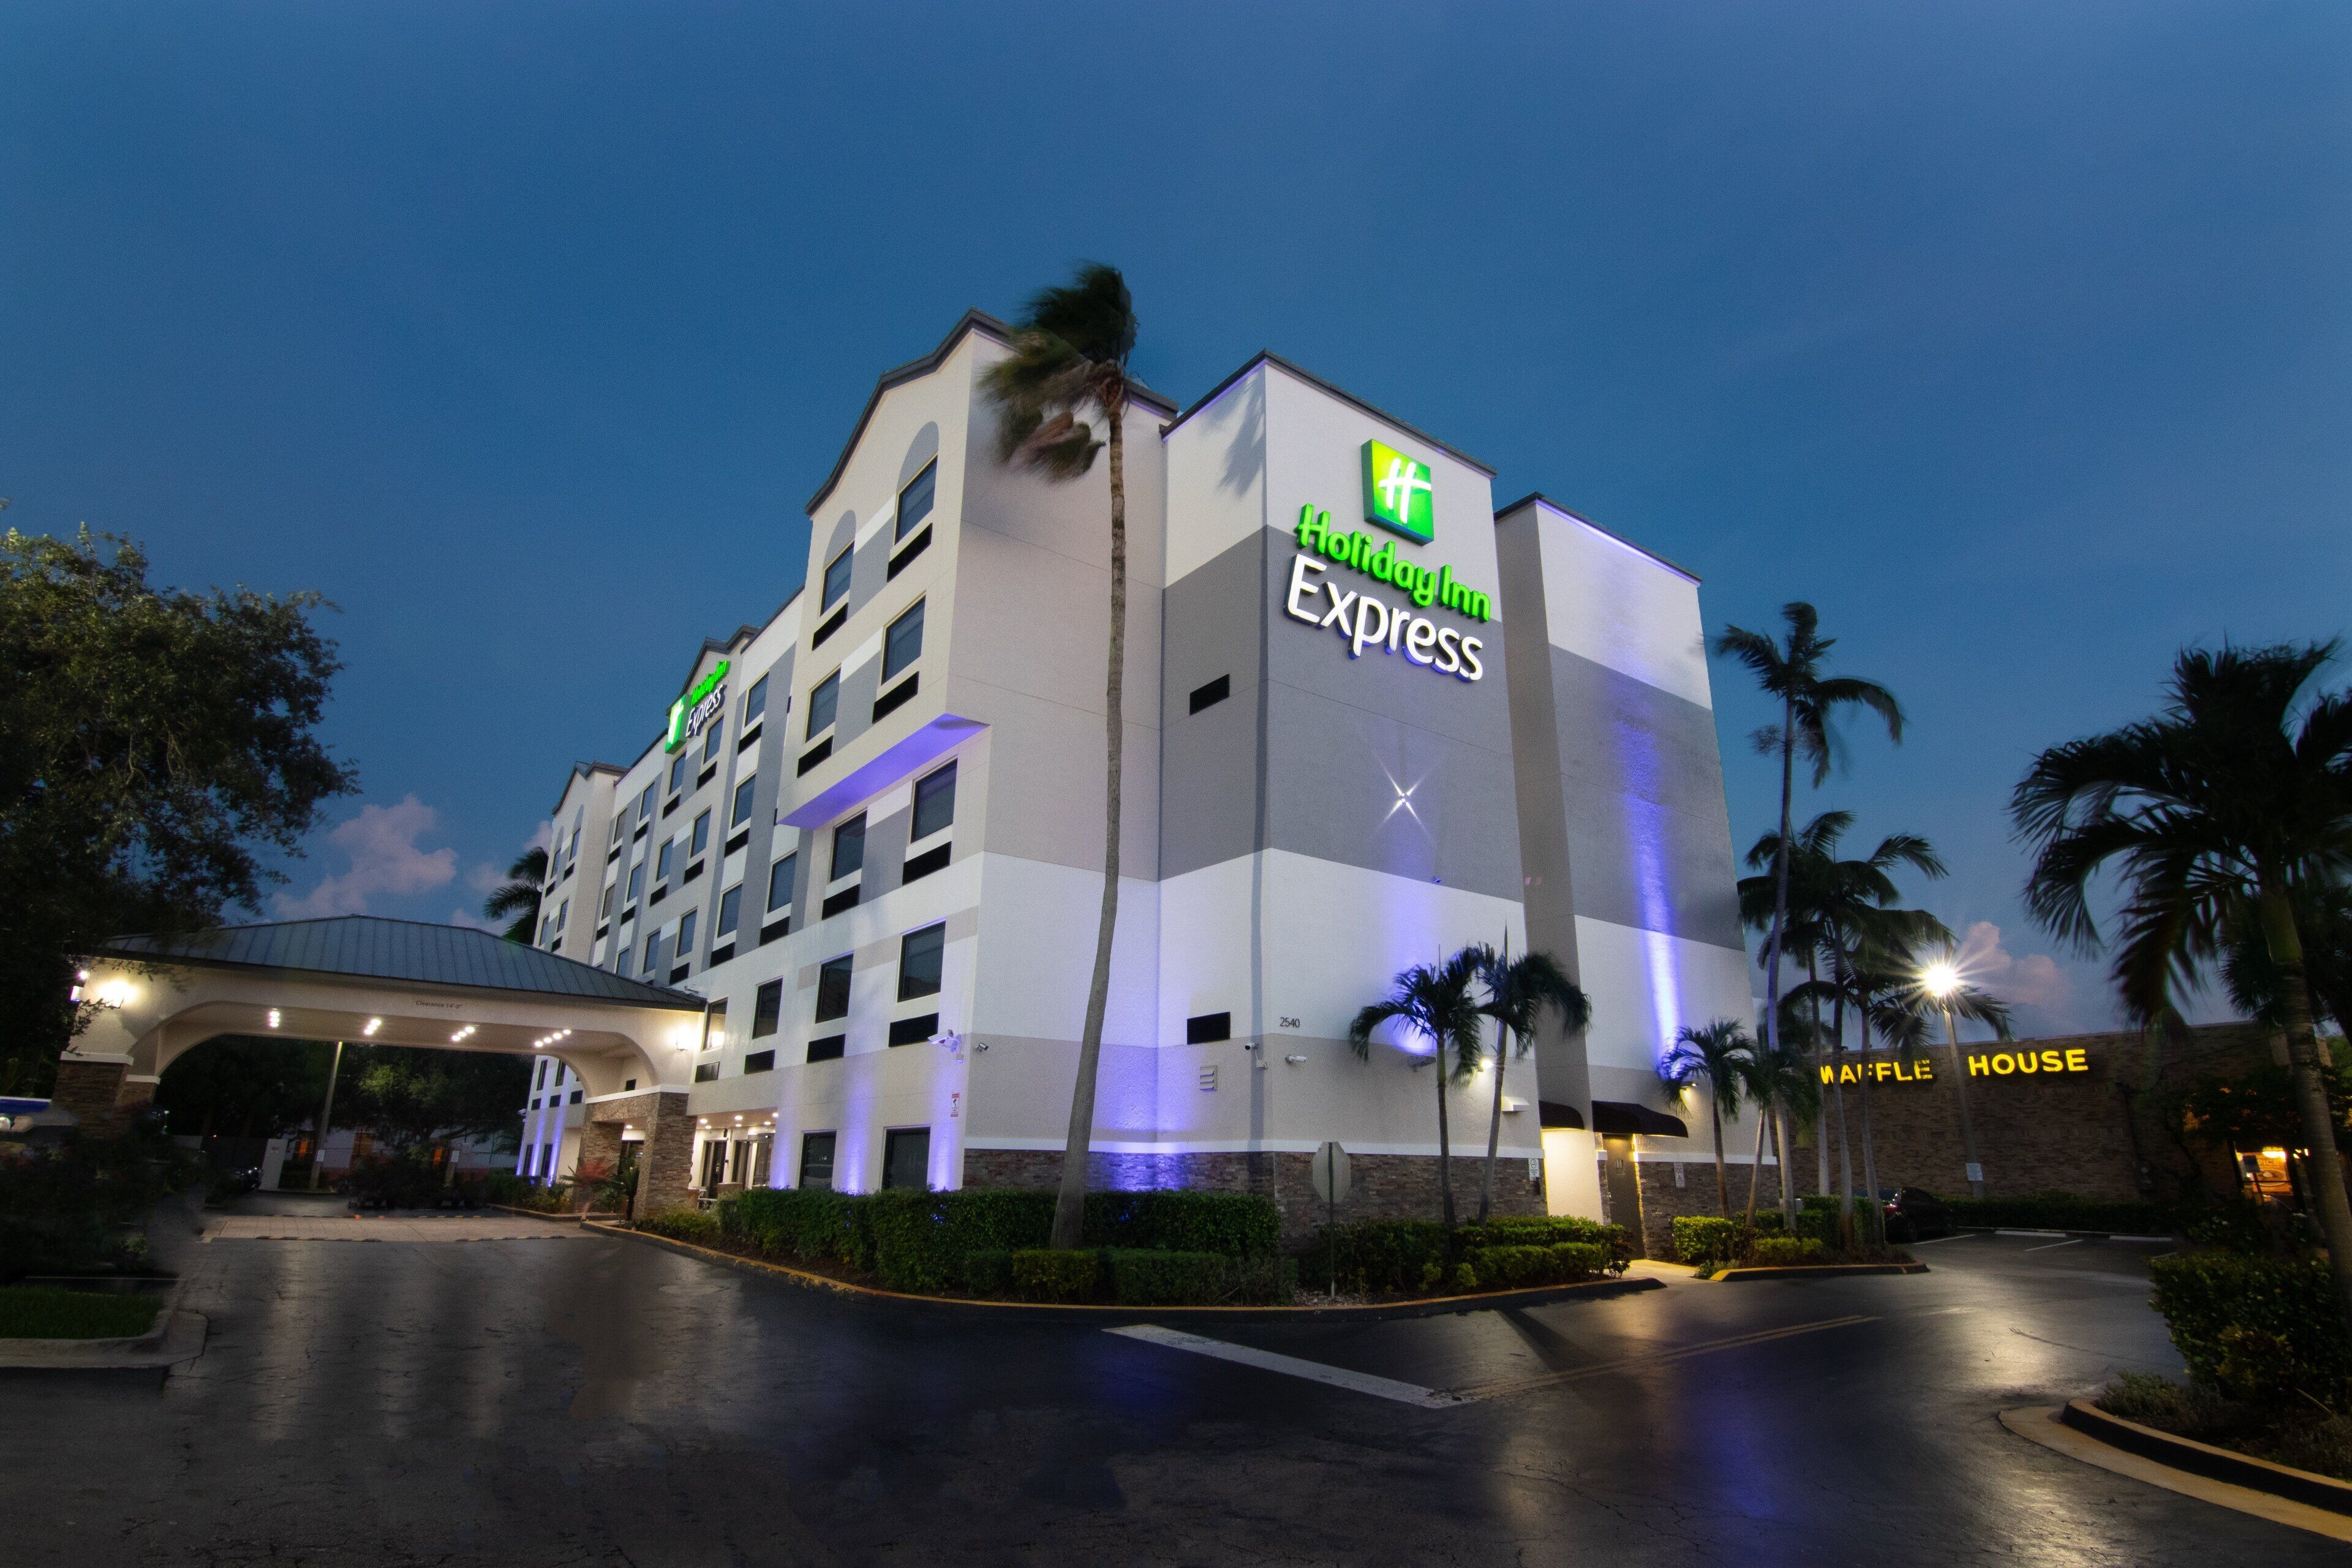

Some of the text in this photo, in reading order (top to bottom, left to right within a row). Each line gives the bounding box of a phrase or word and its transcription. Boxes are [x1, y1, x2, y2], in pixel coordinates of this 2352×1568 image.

[1295, 503, 1490, 622] Holiday Inn
[1287, 553, 1483, 681] Express
[685, 684, 724, 737] Express
[1280, 1017, 1300, 1028] 2540
[1968, 1049, 2089, 1076] HOUSE
